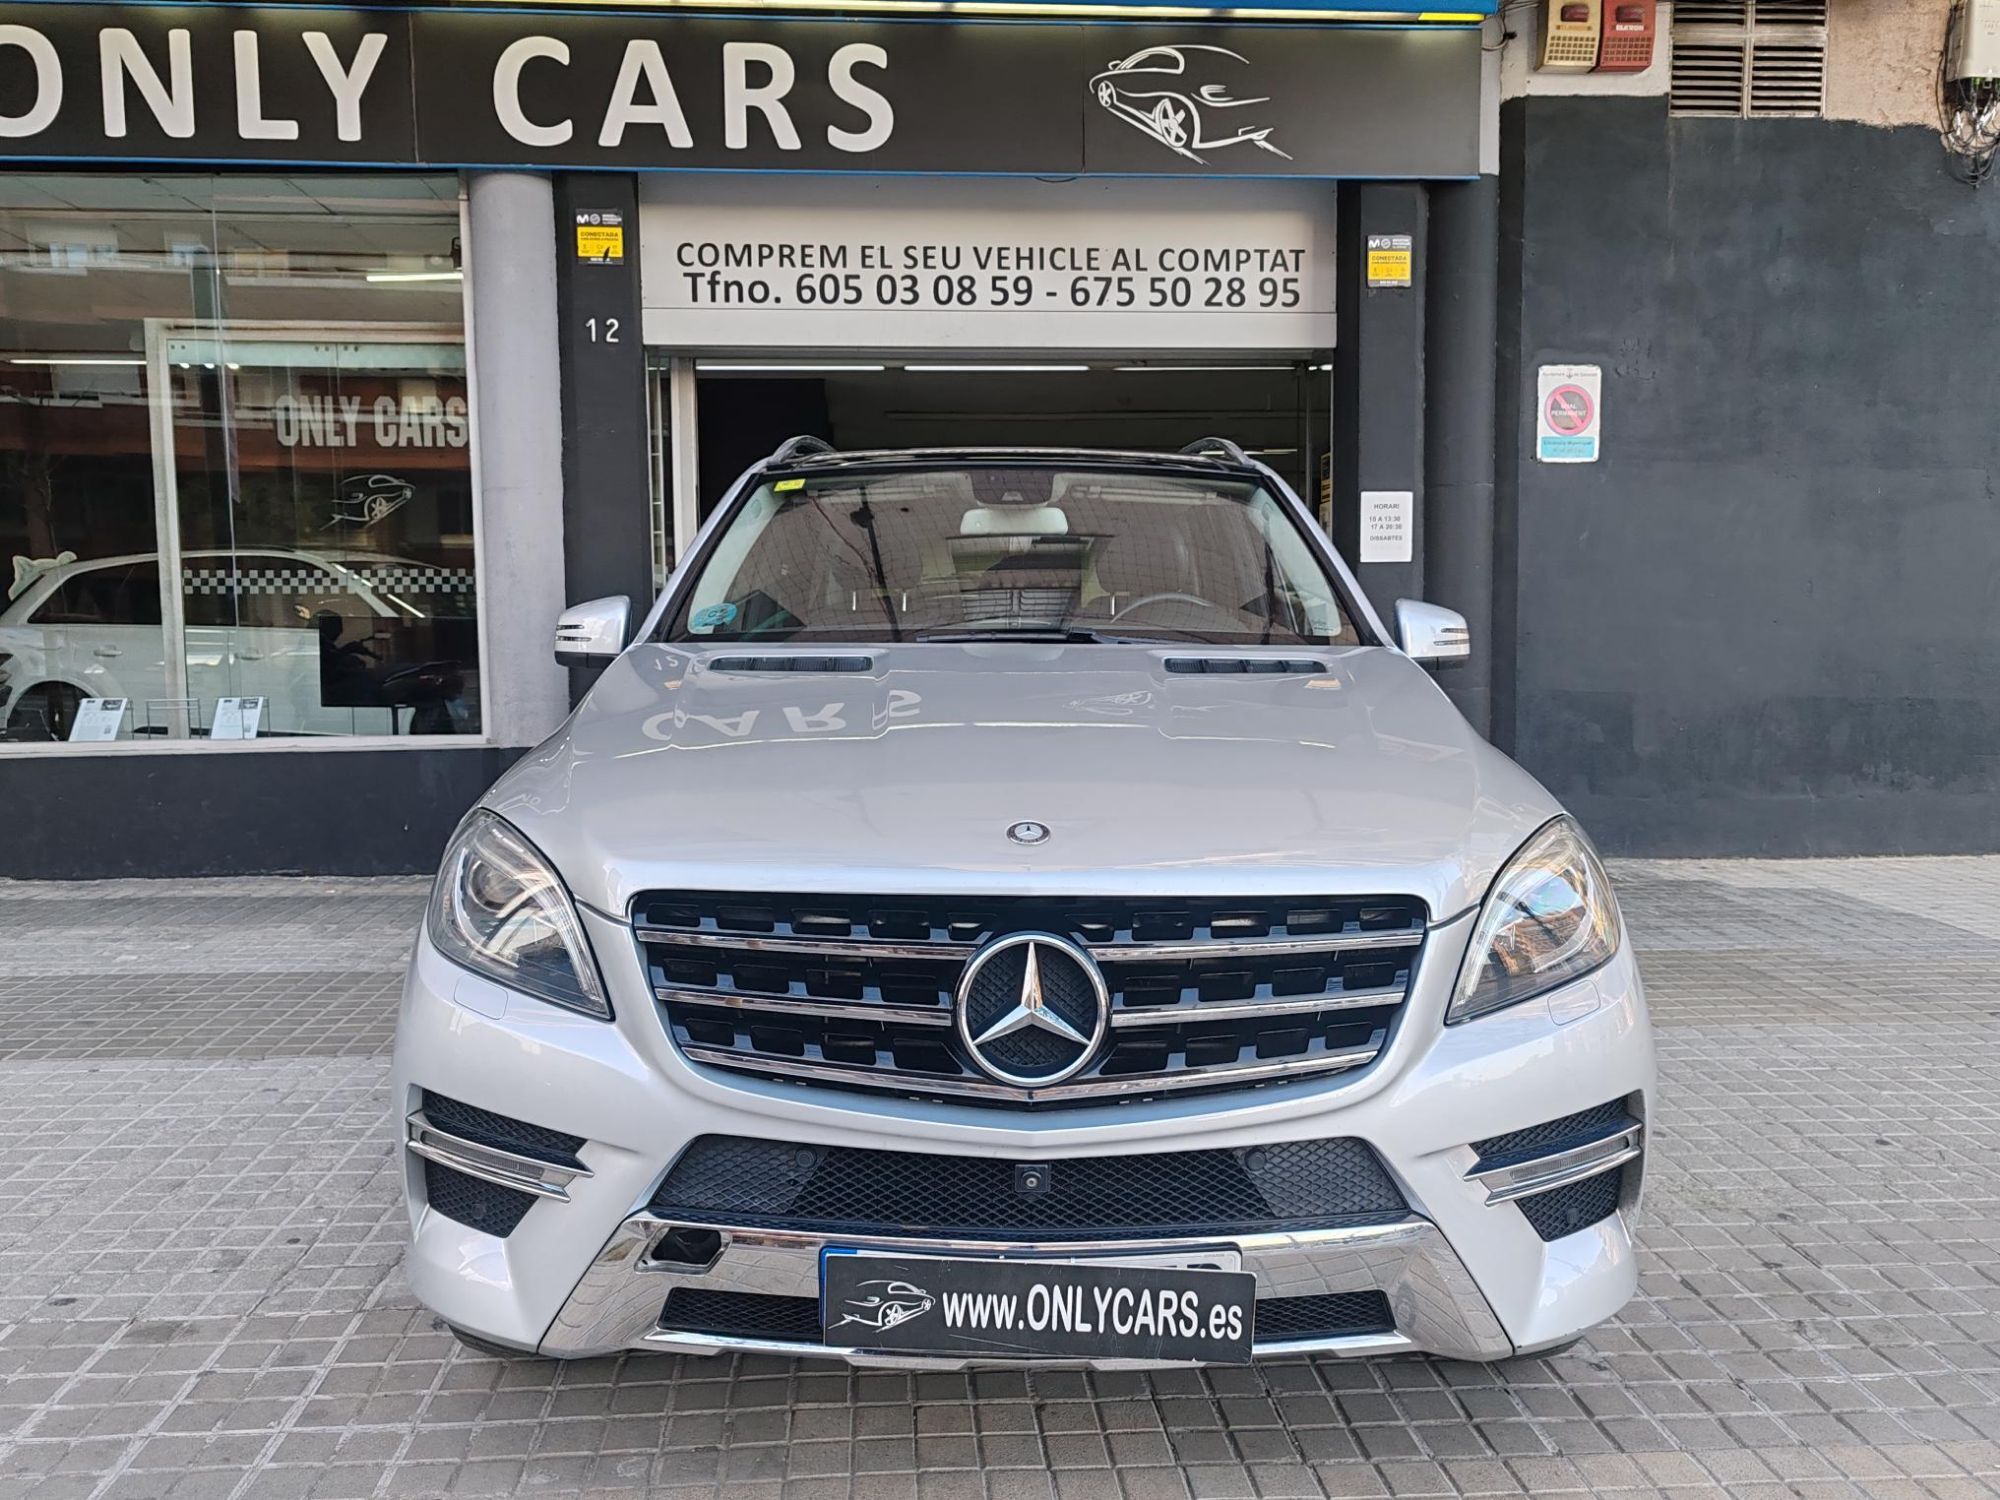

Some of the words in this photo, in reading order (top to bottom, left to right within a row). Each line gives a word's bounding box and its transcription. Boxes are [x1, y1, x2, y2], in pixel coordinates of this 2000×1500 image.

[0, 24, 388, 142] ONLY
[492, 36, 895, 153] CARS
[677, 242, 848, 269] COMPREM
[860, 245, 893, 269] EL
[903, 245, 962, 270] SEU
[972, 246, 1100, 271] VEHICLE
[1112, 247, 1148, 272] AL
[1158, 248, 1306, 272] COMPTAT
[683, 270, 781, 304] Tfno.
[796, 273, 863, 305] 605
[876, 274, 920, 306] 03
[933, 275, 977, 306] 08
[990, 276, 1033, 307] 59
[1070, 276, 1136, 307] 675
[1149, 277, 1191, 307] 50
[1204, 277, 1246, 308] 28
[1258, 277, 1301, 308] 95
[585, 318, 619, 343] 12
[276, 395, 361, 447] ONLY
[374, 396, 468, 448] CARS
[942, 1283, 1243, 1340] www.ONLYCARS.es
